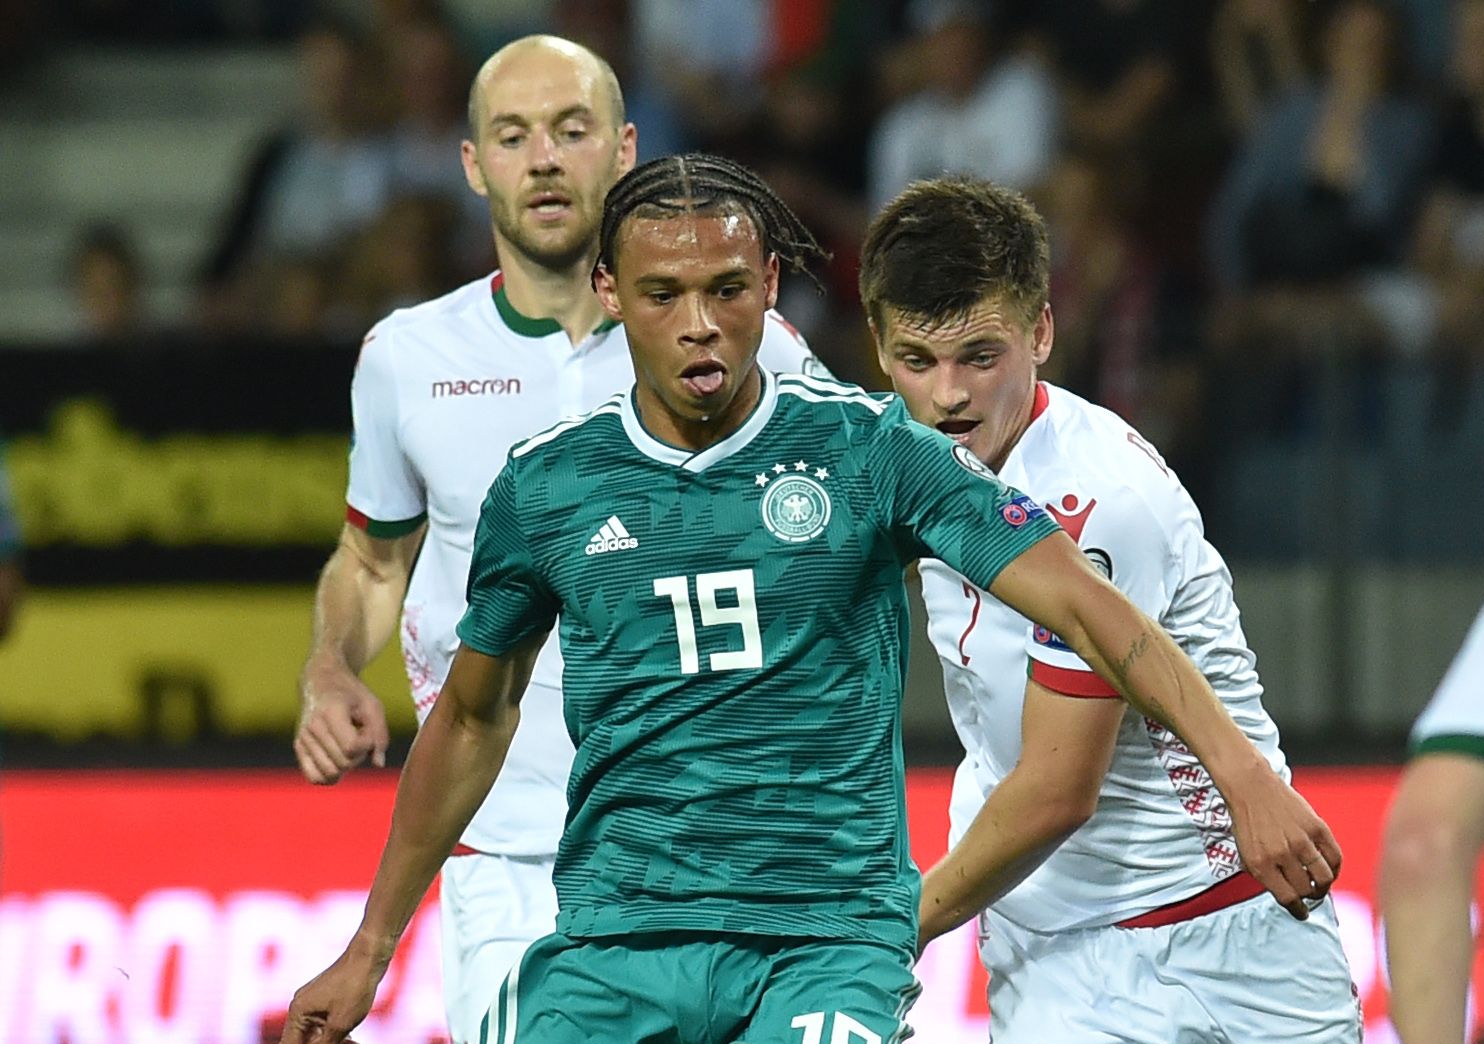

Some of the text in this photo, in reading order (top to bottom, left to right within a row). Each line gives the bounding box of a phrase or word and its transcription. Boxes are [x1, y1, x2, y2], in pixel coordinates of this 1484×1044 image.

[431, 378, 521, 399] macron
[585, 536, 639, 556] adidas
[652, 568, 763, 675] 19
